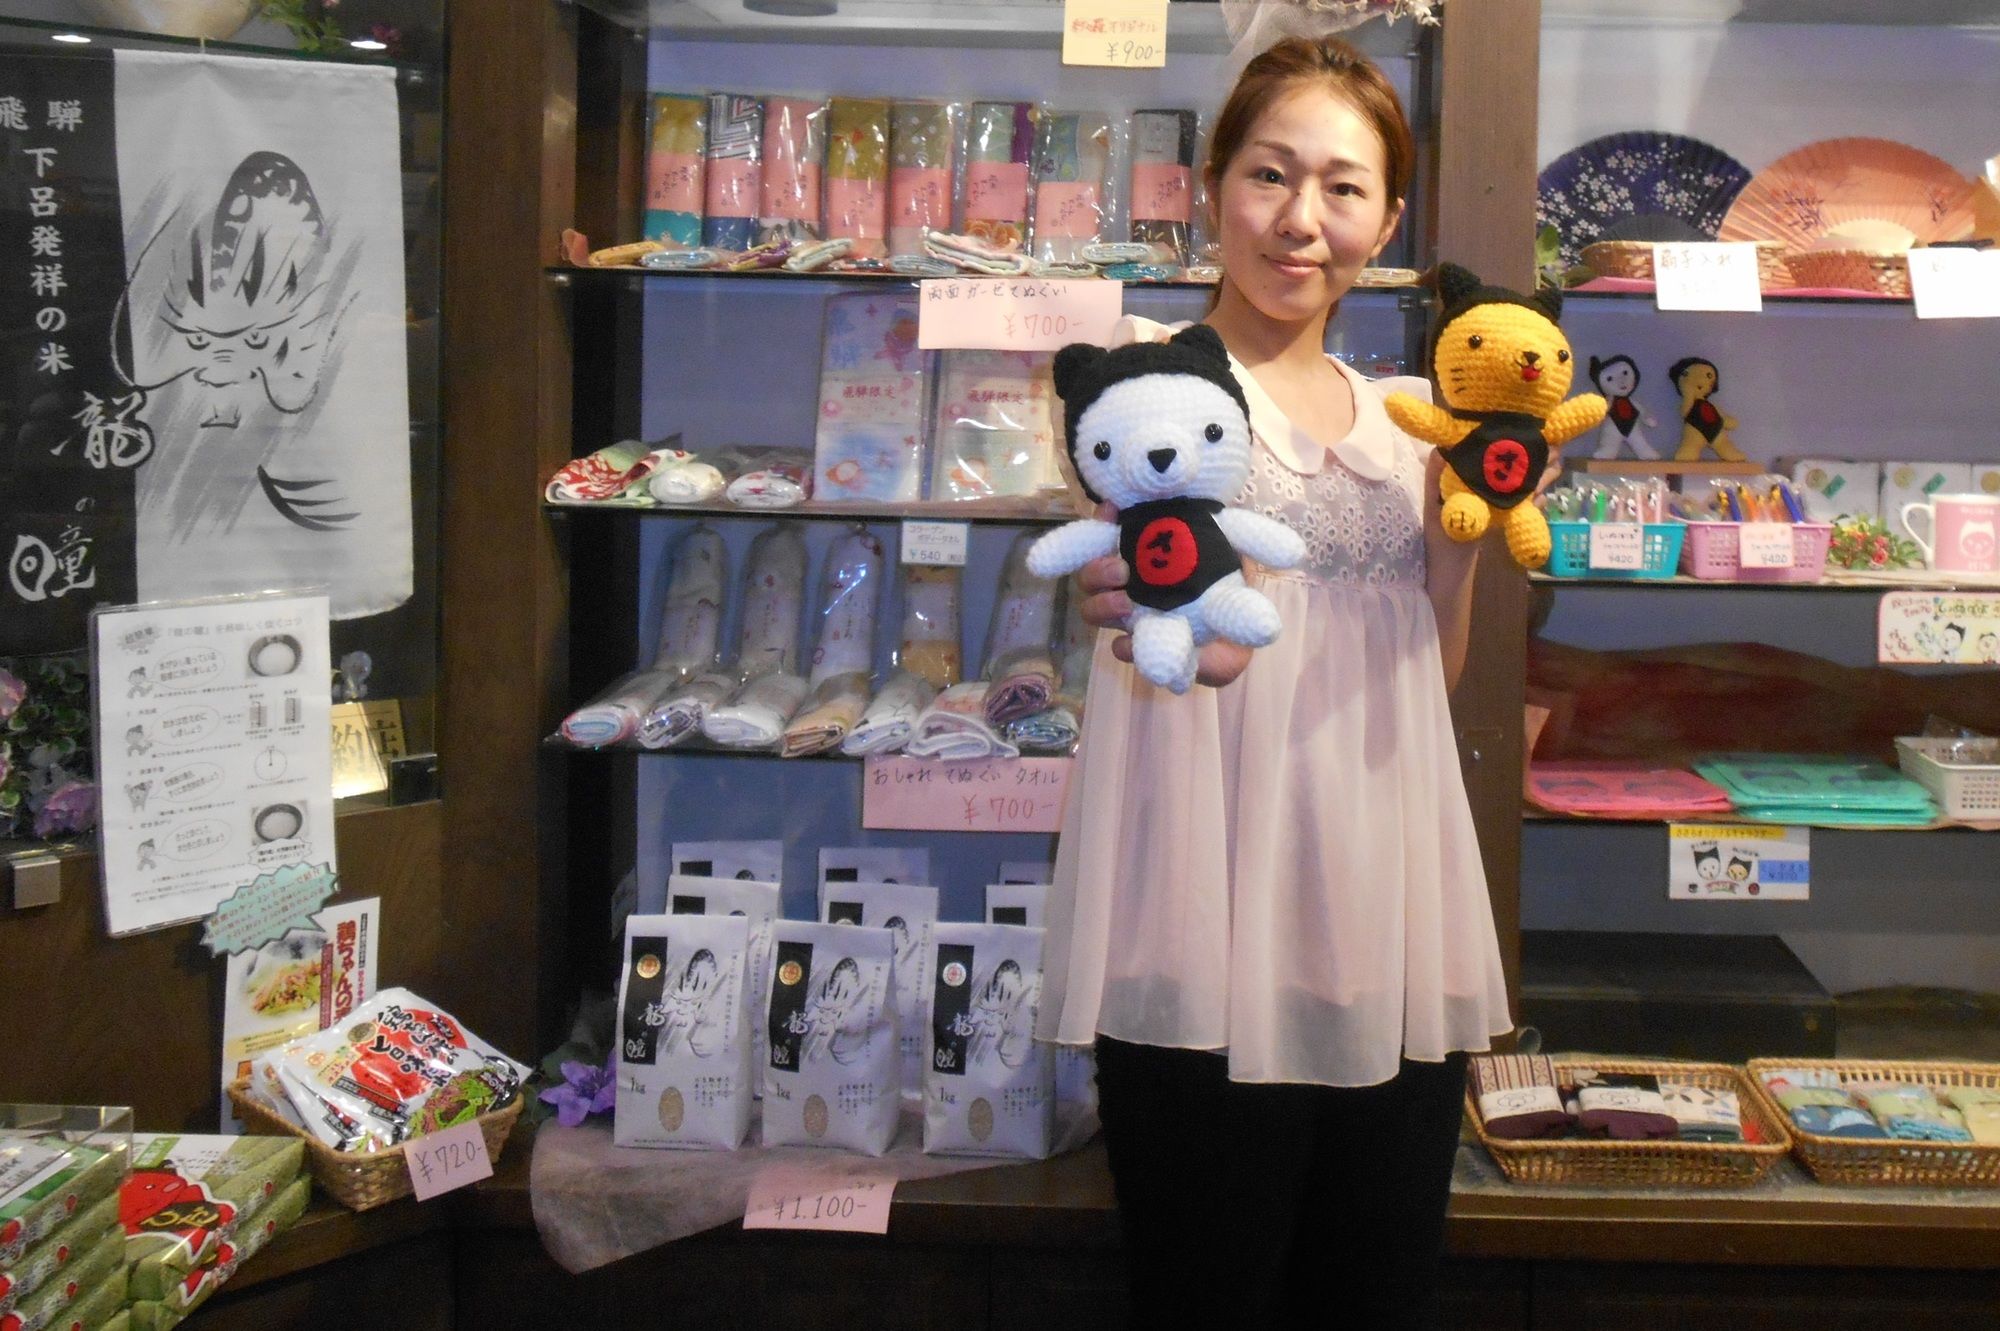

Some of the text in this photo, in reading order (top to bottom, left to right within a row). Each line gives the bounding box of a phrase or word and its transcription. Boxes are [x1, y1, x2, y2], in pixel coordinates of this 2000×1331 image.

[1106, 40, 1163, 64] ¥900-
[23, 147, 75, 376] 下呂発祥の米
[1002, 313, 1084, 339] ¥700-
[961, 793, 1056, 825] ¥700-
[414, 1140, 482, 1184] ¥720-
